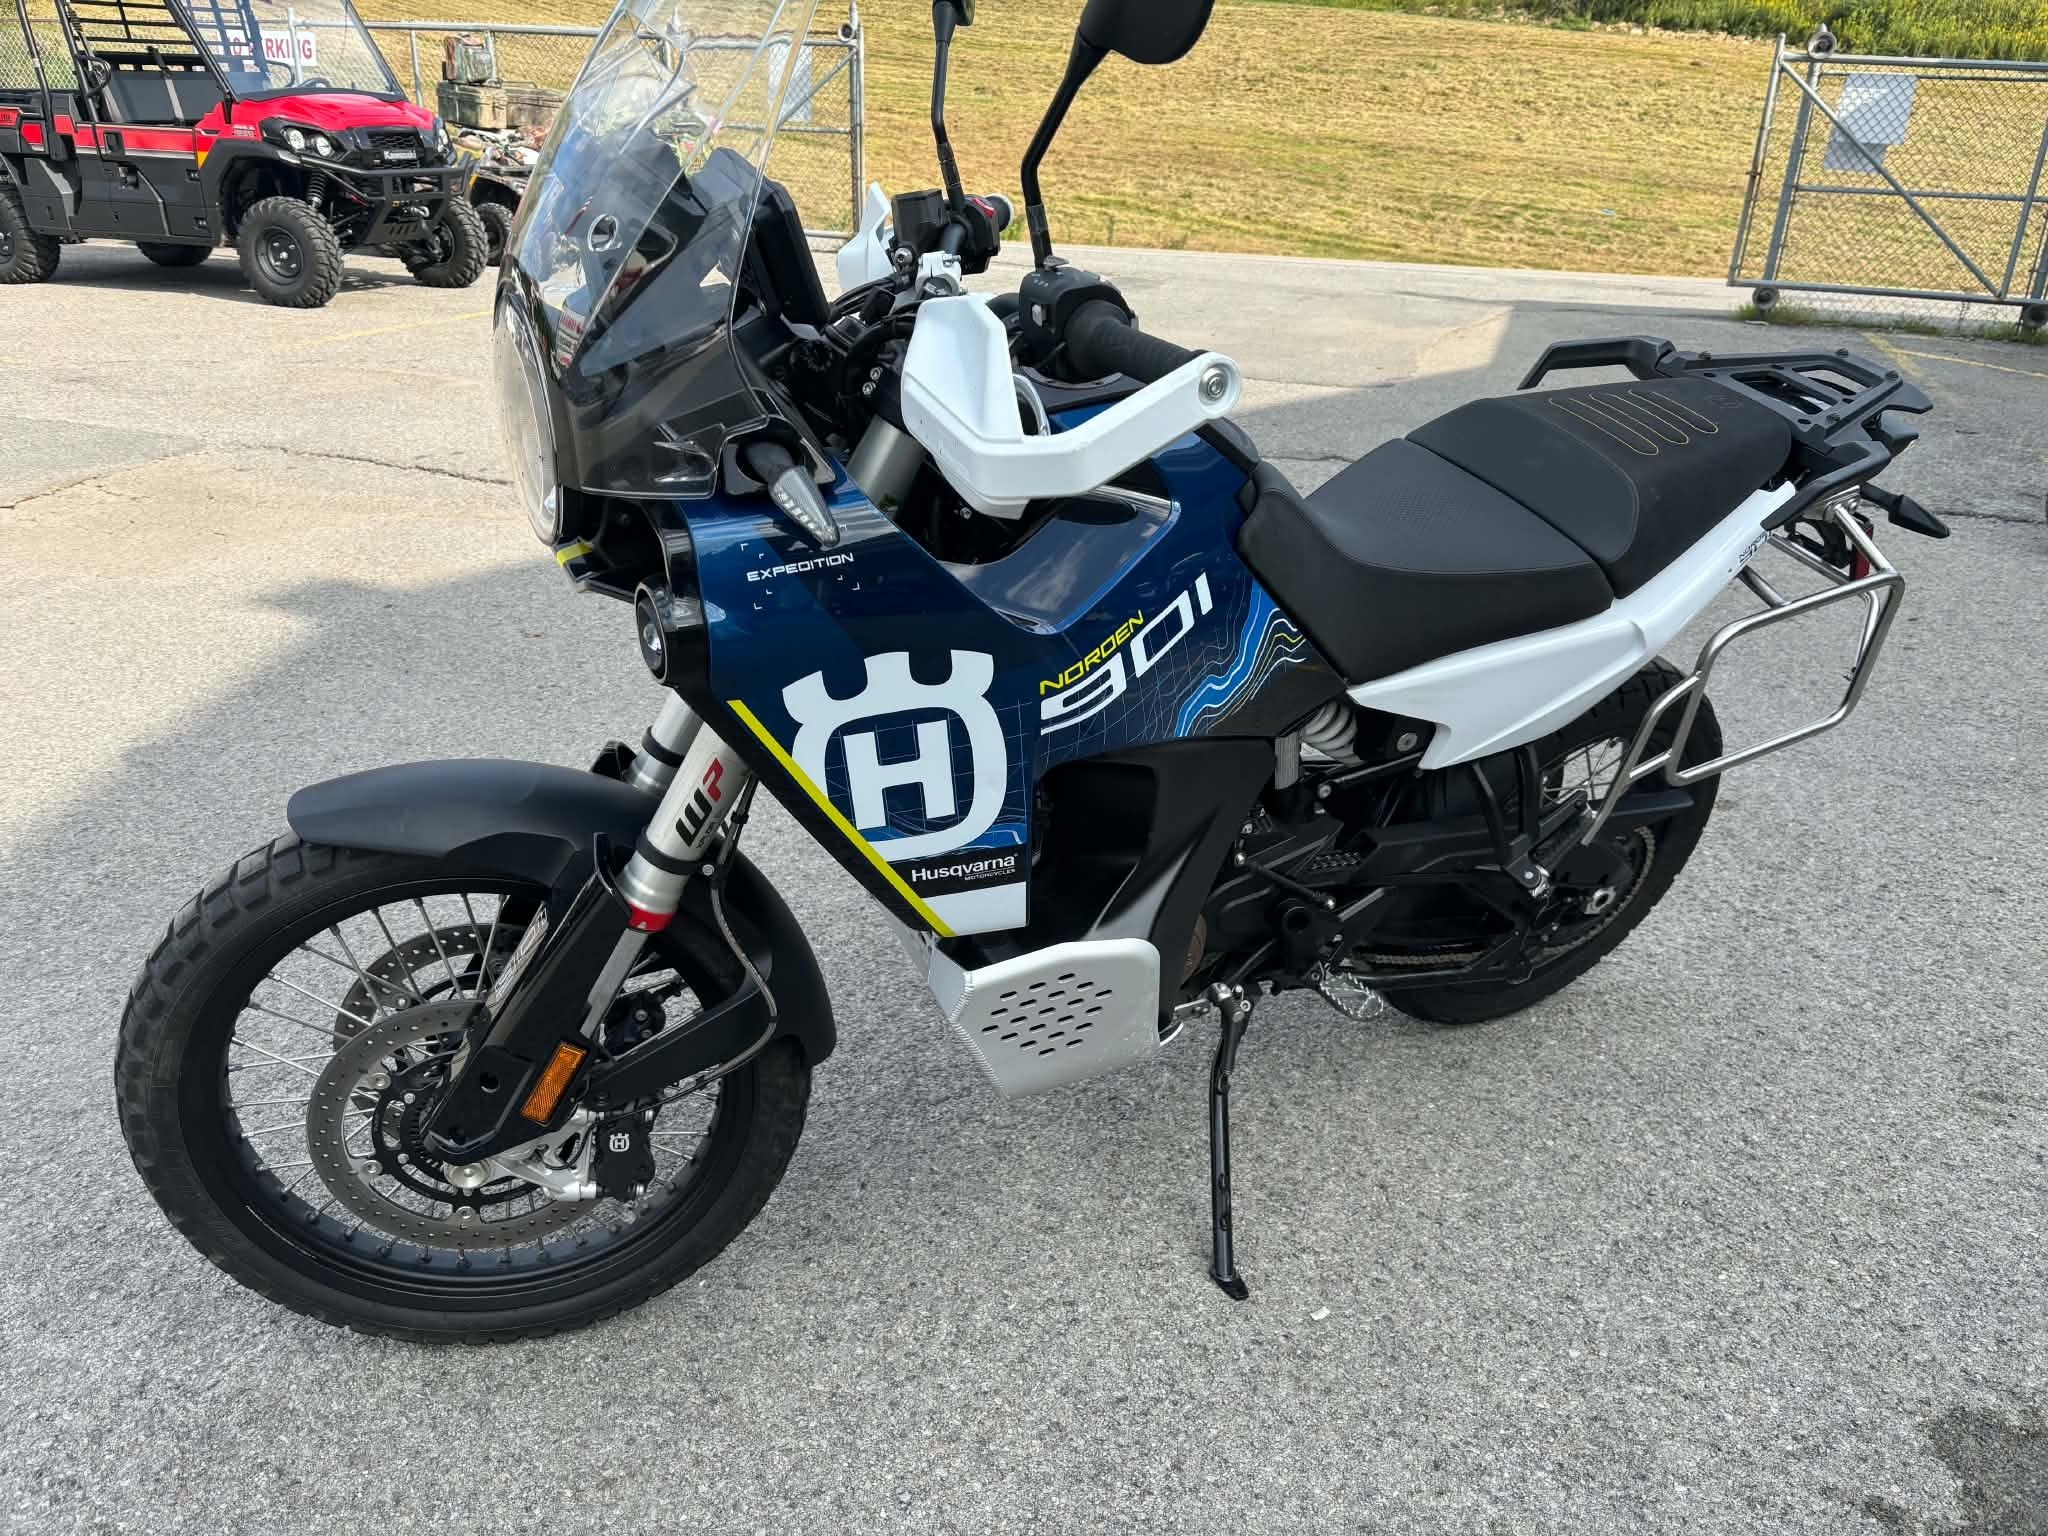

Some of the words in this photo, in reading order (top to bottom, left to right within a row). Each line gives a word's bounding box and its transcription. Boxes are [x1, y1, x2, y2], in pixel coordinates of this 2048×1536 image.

[746, 552, 855, 582] EXPEDITION
[1039, 609, 1144, 695] NORDEN
[1040, 572, 1213, 736] 901
[675, 757, 724, 848] WP
[843, 719, 956, 831] H
[911, 855, 1016, 882] Husqvarna
